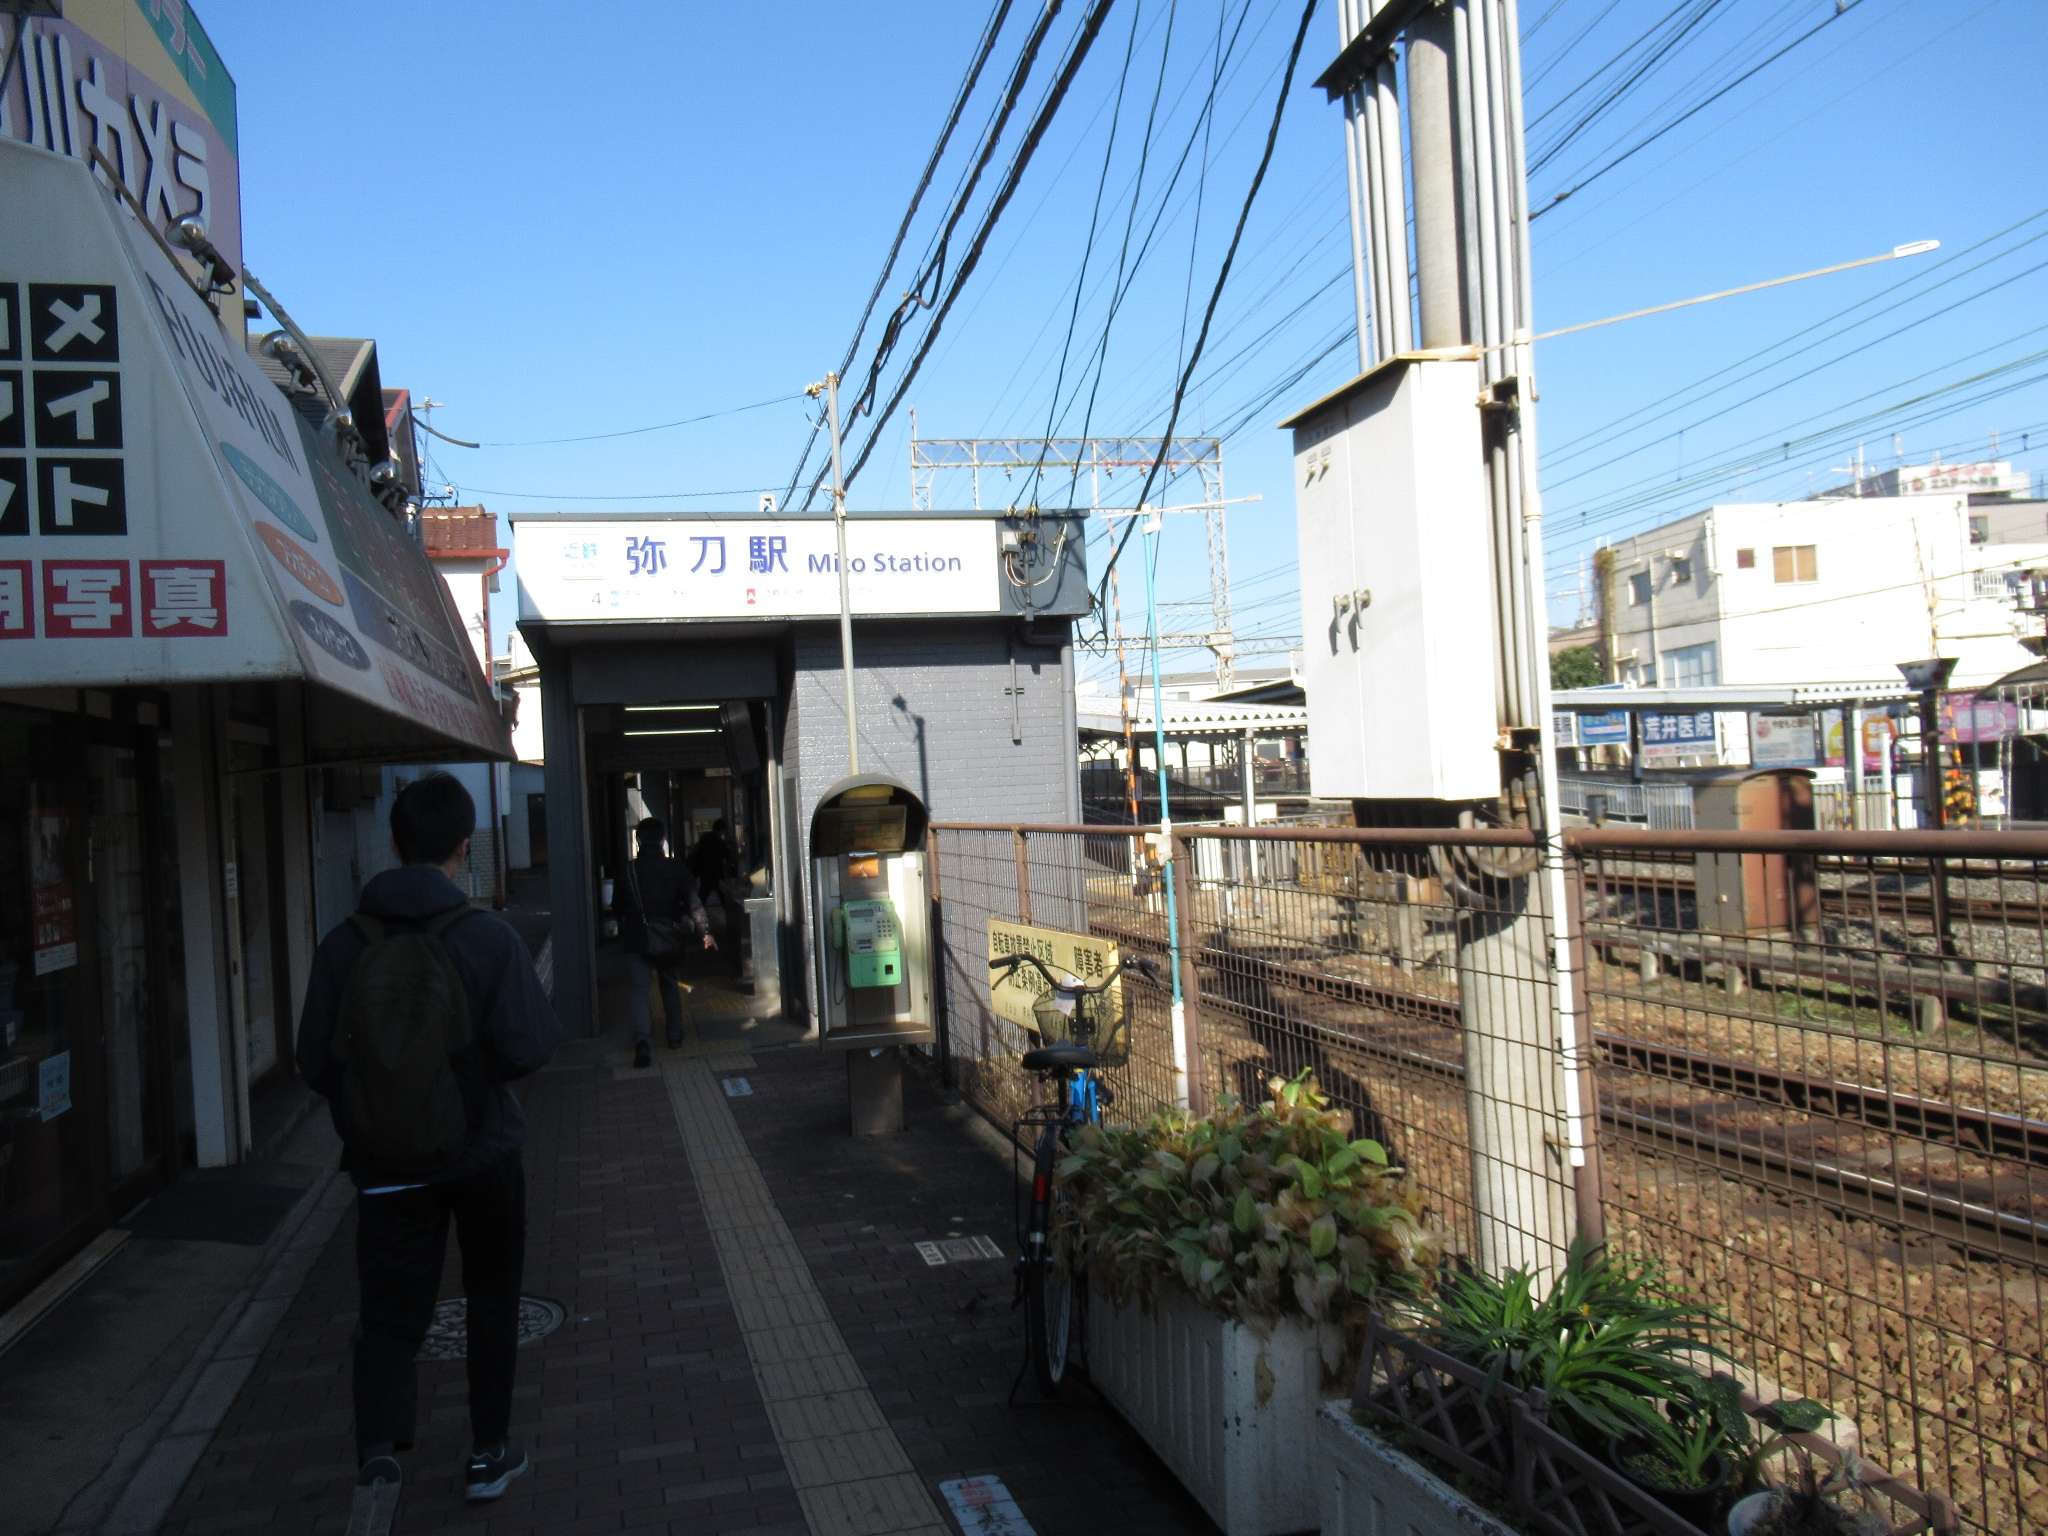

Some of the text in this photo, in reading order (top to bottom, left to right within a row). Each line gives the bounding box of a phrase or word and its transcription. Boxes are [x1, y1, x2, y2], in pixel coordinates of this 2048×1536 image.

[146, 272, 301, 476] FUJIFILM
[626, 535, 789, 576] 弥刀駅
[874, 551, 962, 573] Station
[1645, 713, 1713, 741] 荒井医院
